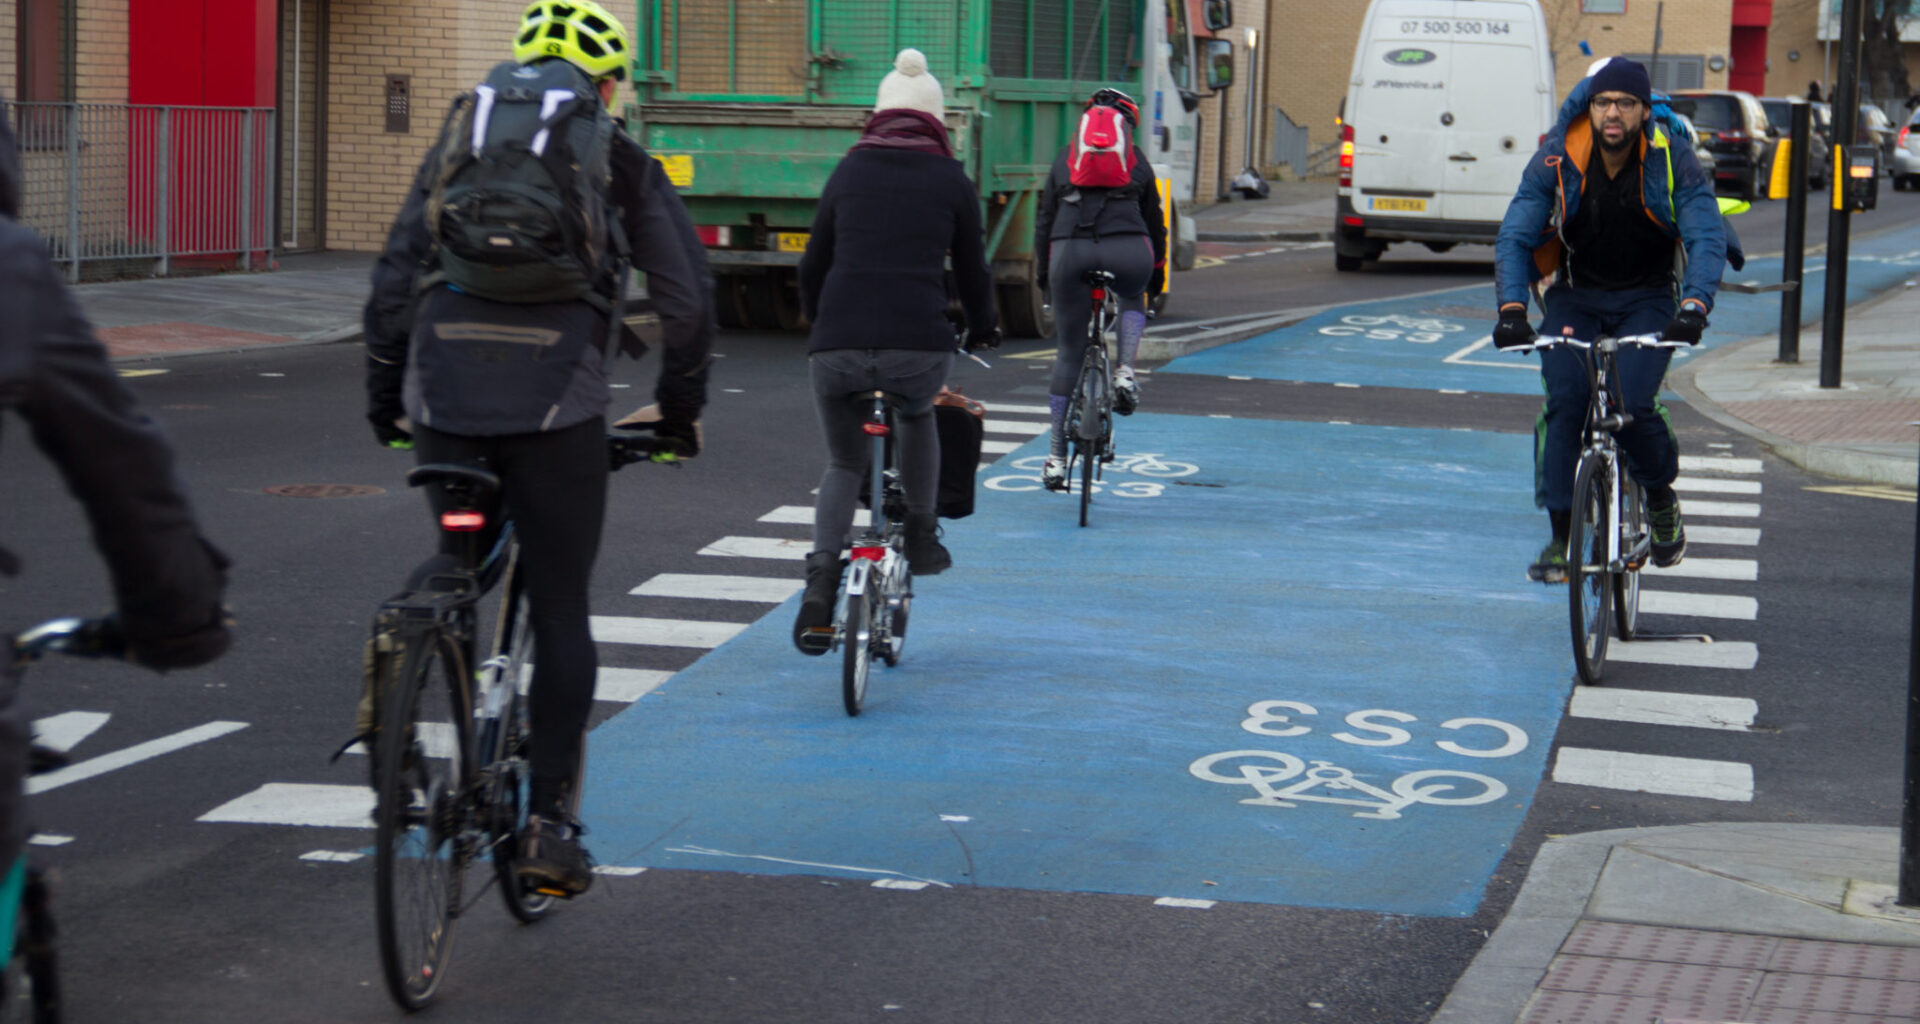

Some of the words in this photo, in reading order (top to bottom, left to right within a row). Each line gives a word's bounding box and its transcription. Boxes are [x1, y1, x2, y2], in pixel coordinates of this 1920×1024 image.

[1401, 21, 1419, 34] 07
[1423, 21, 1450, 34] 500
[1455, 22, 1482, 35] 500
[1487, 22, 1510, 35] 164
[1318, 325, 1444, 344] CS3
[983, 474, 1166, 498] CS3
[1241, 700, 1529, 758] CS3
